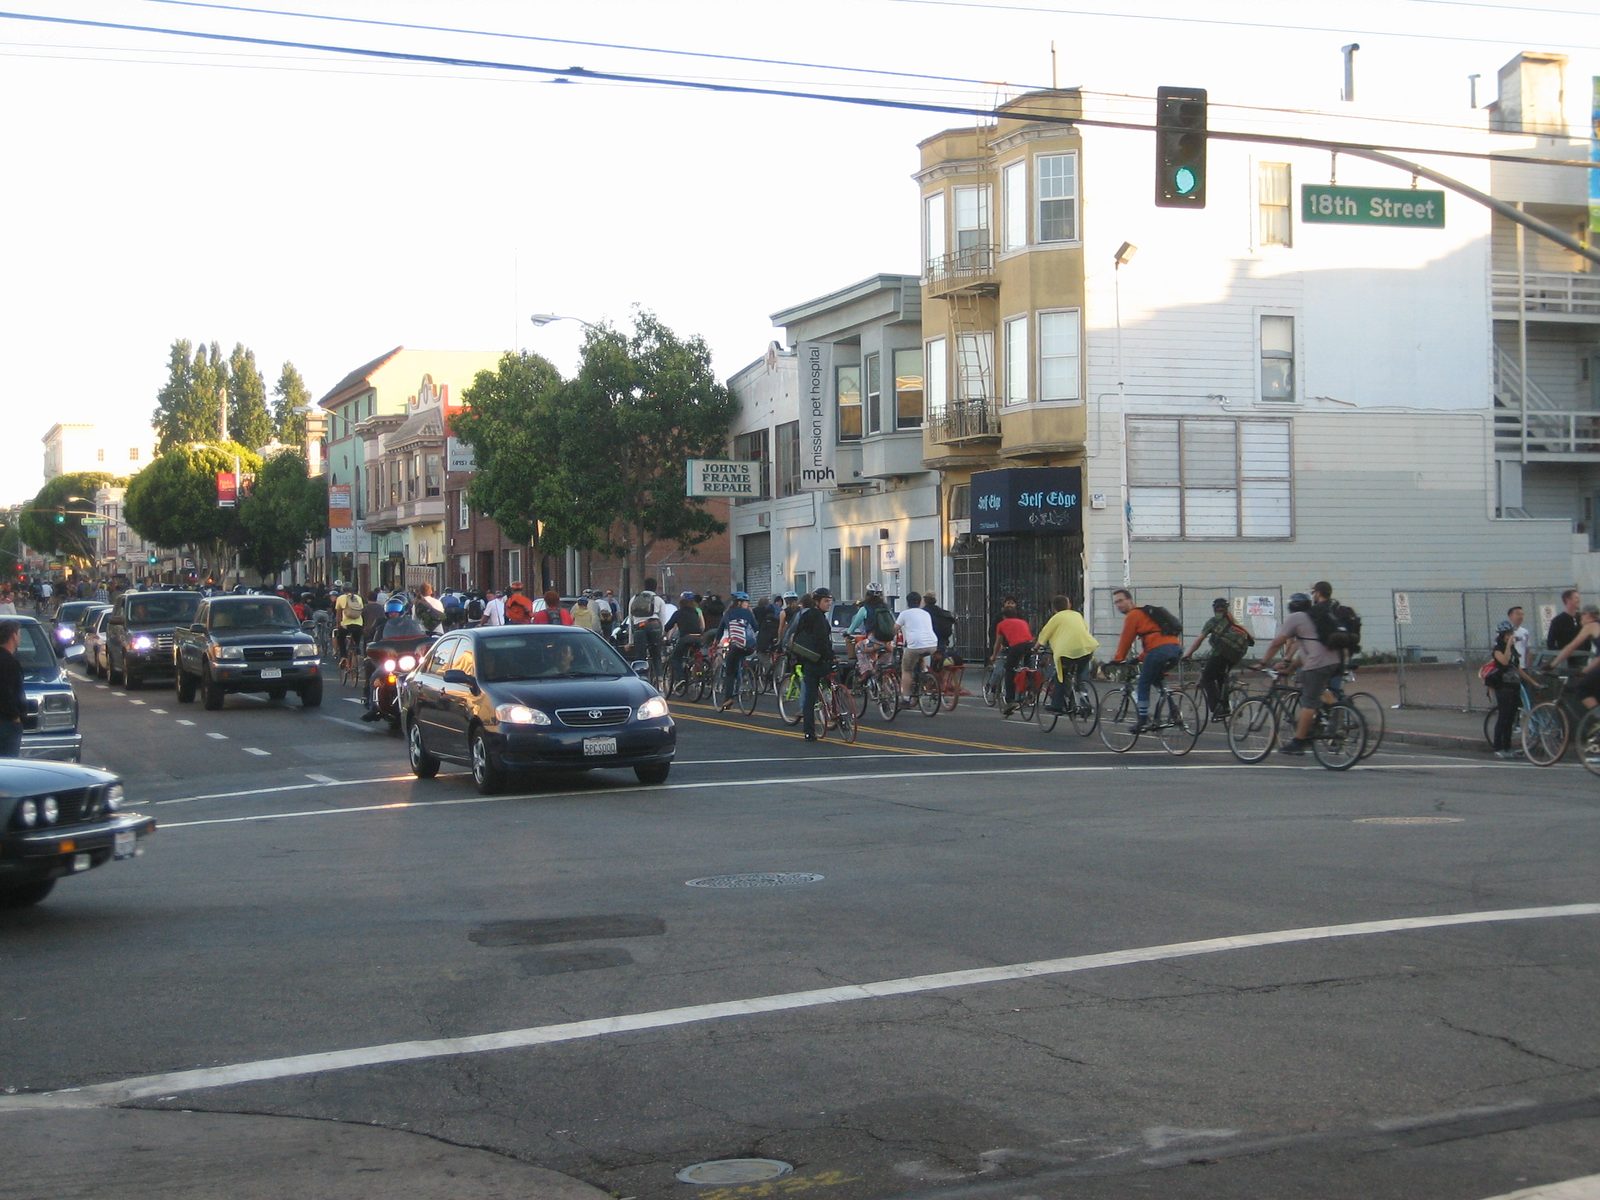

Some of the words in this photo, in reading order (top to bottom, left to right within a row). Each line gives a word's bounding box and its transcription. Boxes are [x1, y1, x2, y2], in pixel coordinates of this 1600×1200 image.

[1310, 194, 1357, 216] 18th
[1369, 197, 1434, 219] Street
[808, 346, 823, 394] hospital
[811, 397, 824, 417] pet
[810, 420, 822, 467] mission
[702, 463, 749, 474] JOHN'S
[802, 466, 835, 483] mph
[702, 473, 751, 483] FRAME
[703, 483, 752, 493] REPAIR
[1018, 492, 1044, 508] Self
[1046, 491, 1077, 508] Edge
